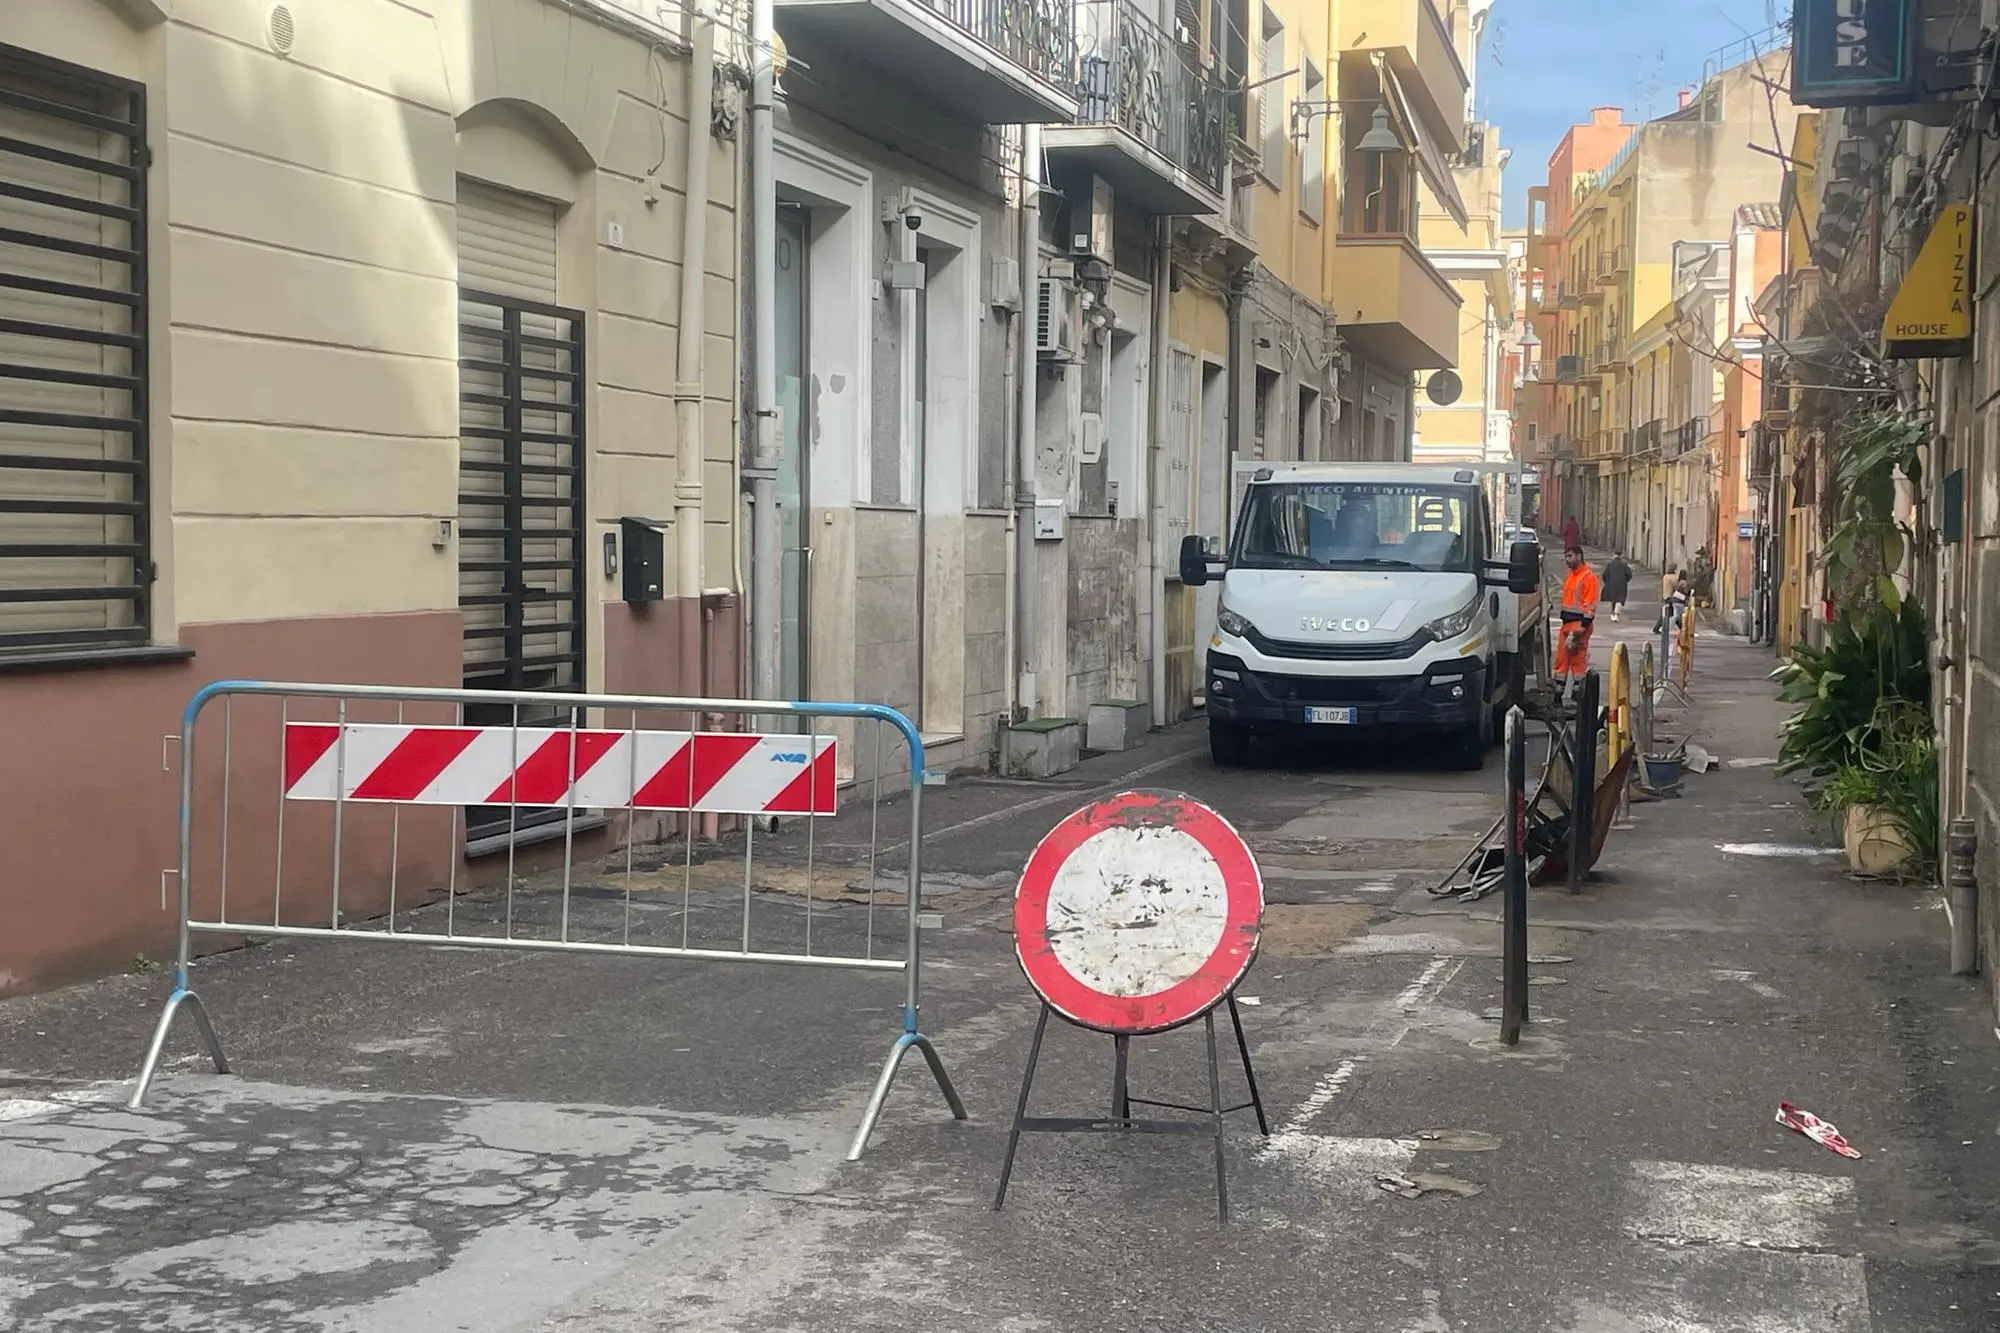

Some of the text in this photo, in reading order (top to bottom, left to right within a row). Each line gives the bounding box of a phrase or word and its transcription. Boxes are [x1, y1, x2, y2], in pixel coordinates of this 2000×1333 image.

[1951, 210, 1967, 314] PIZZA
[1895, 323, 1949, 336] HOUSE
[1297, 485, 1345, 495] IVECO
[1300, 616, 1371, 633] IVECO
